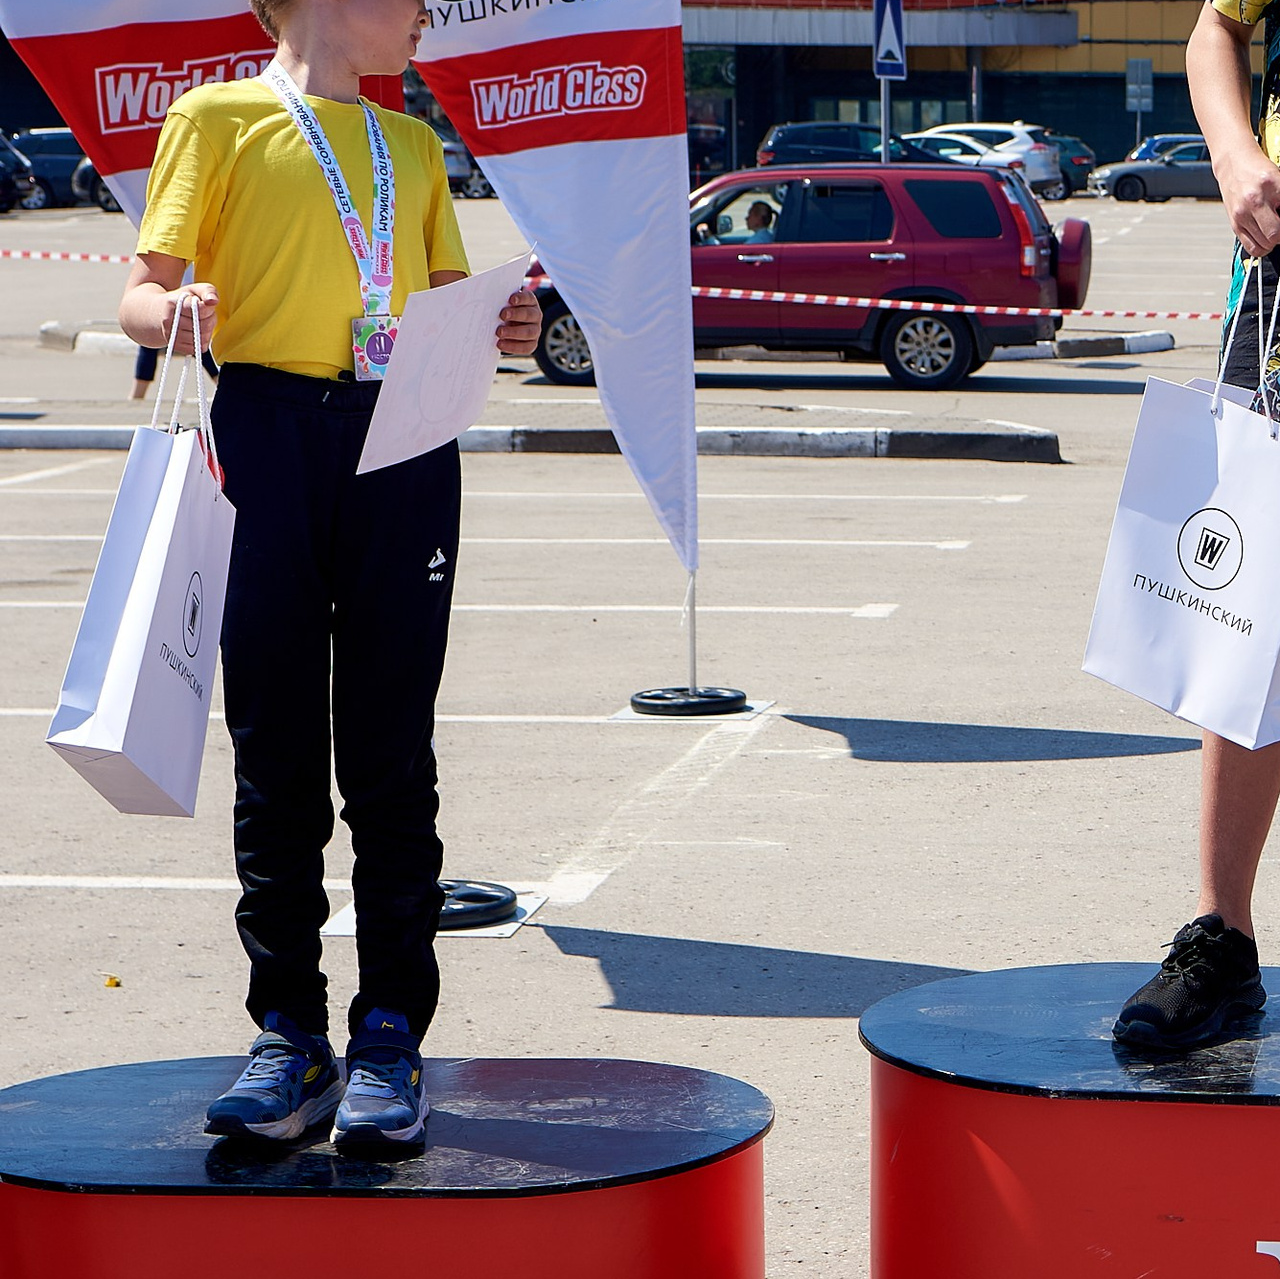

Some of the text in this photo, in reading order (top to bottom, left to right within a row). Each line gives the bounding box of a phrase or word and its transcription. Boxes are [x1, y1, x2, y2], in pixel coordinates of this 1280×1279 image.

[479, 67, 641, 123] World Class
[327, 167, 351, 214] СЕТЕВЫЕ
[379, 160, 388, 176] ПО
[379, 178, 389, 232] РОЛИКАМ
[1133, 574, 1253, 637] ПУШКИНСКИЙ
[159, 642, 203, 702] ПУШКИНСКИЙ
